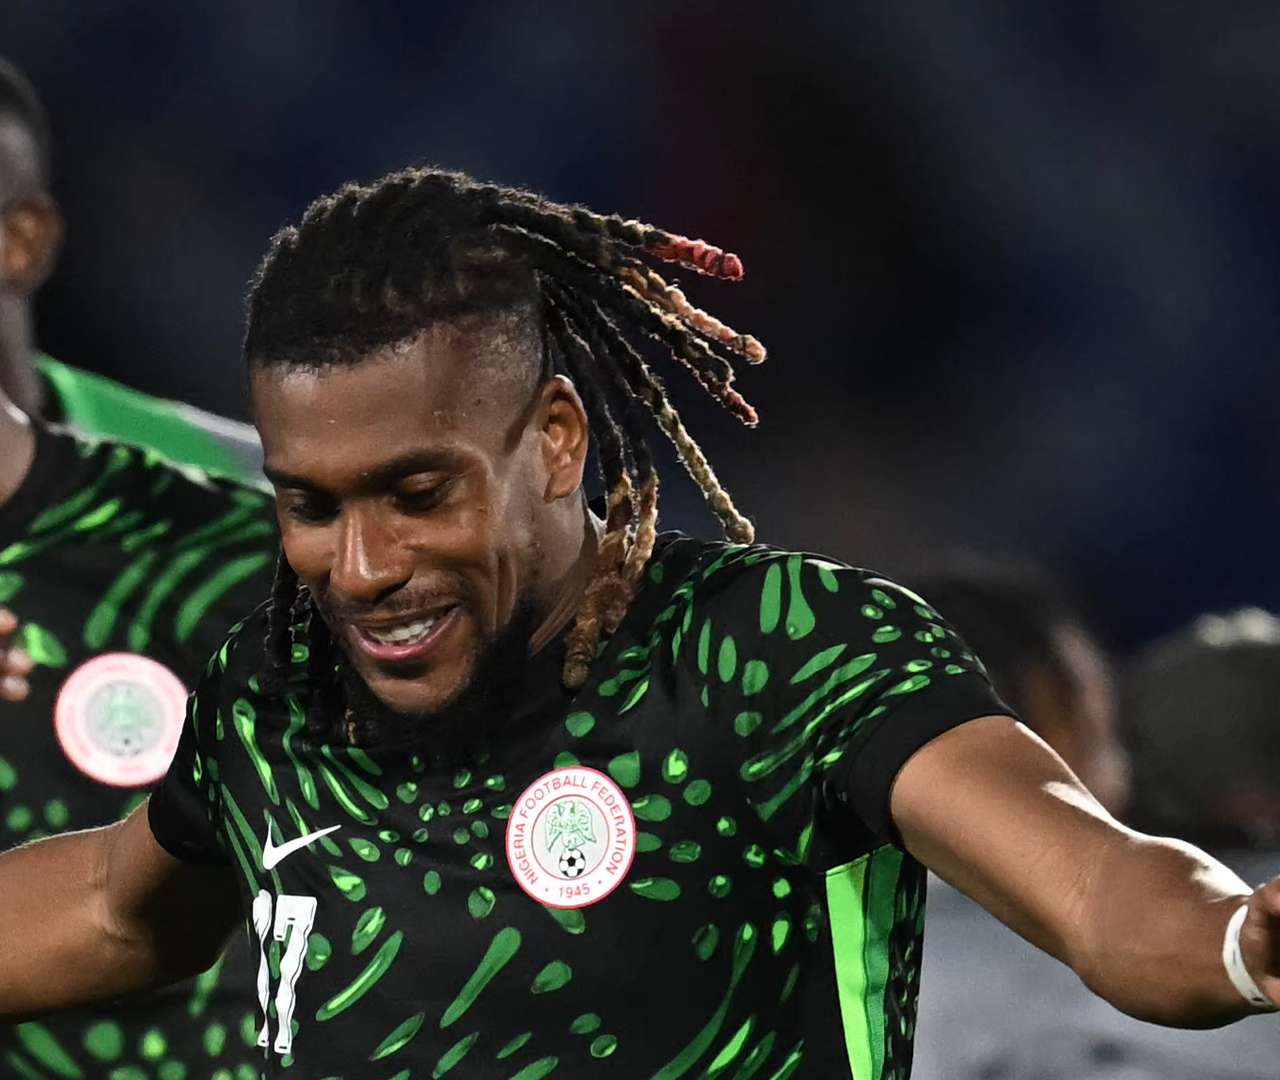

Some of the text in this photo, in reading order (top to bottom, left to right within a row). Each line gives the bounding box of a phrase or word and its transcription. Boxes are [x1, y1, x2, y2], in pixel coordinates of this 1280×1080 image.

[513, 775, 627, 885] NIGERIA FOOTBALL FEDERATION
[559, 883, 591, 899] 1945
[253, 889, 318, 1054] 17
